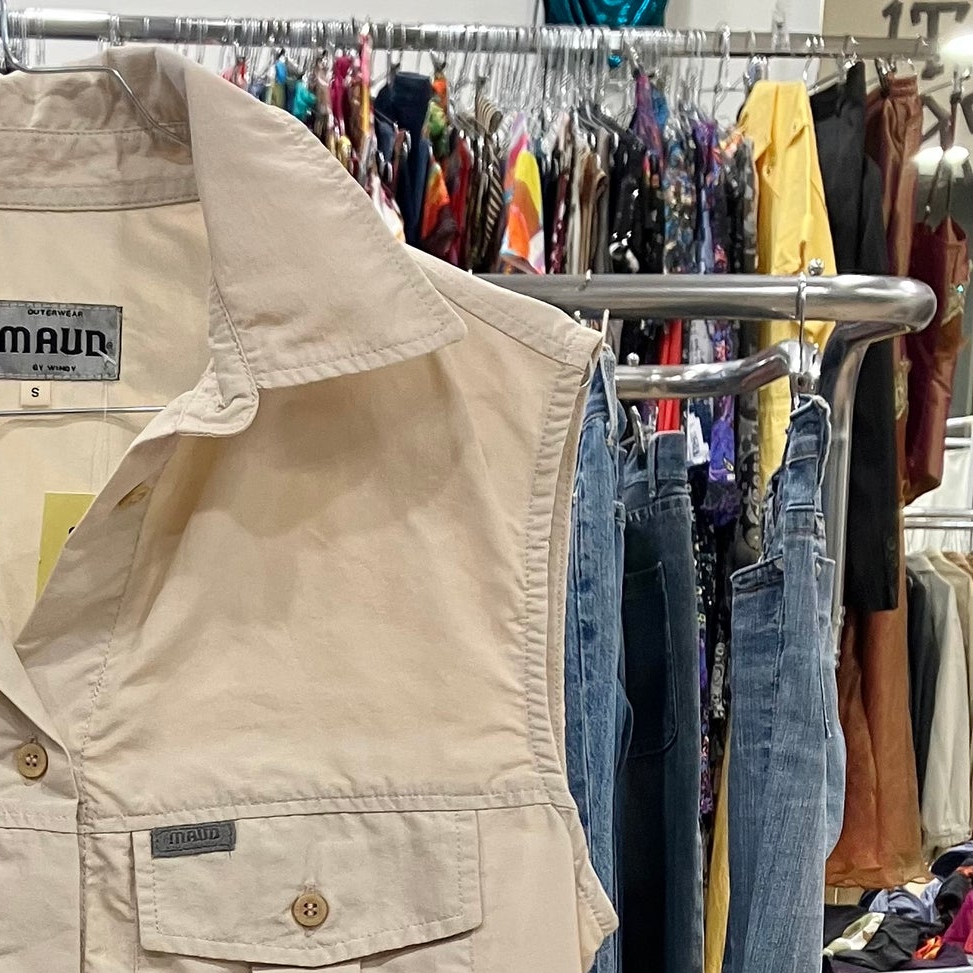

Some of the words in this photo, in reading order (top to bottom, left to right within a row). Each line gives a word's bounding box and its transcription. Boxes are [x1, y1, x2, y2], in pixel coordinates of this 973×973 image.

[27, 308, 84, 318] OUTERWEAR
[32, 363, 44, 372] BY
[47, 364, 77, 373] WINDY
[31, 387, 40, 398] S
